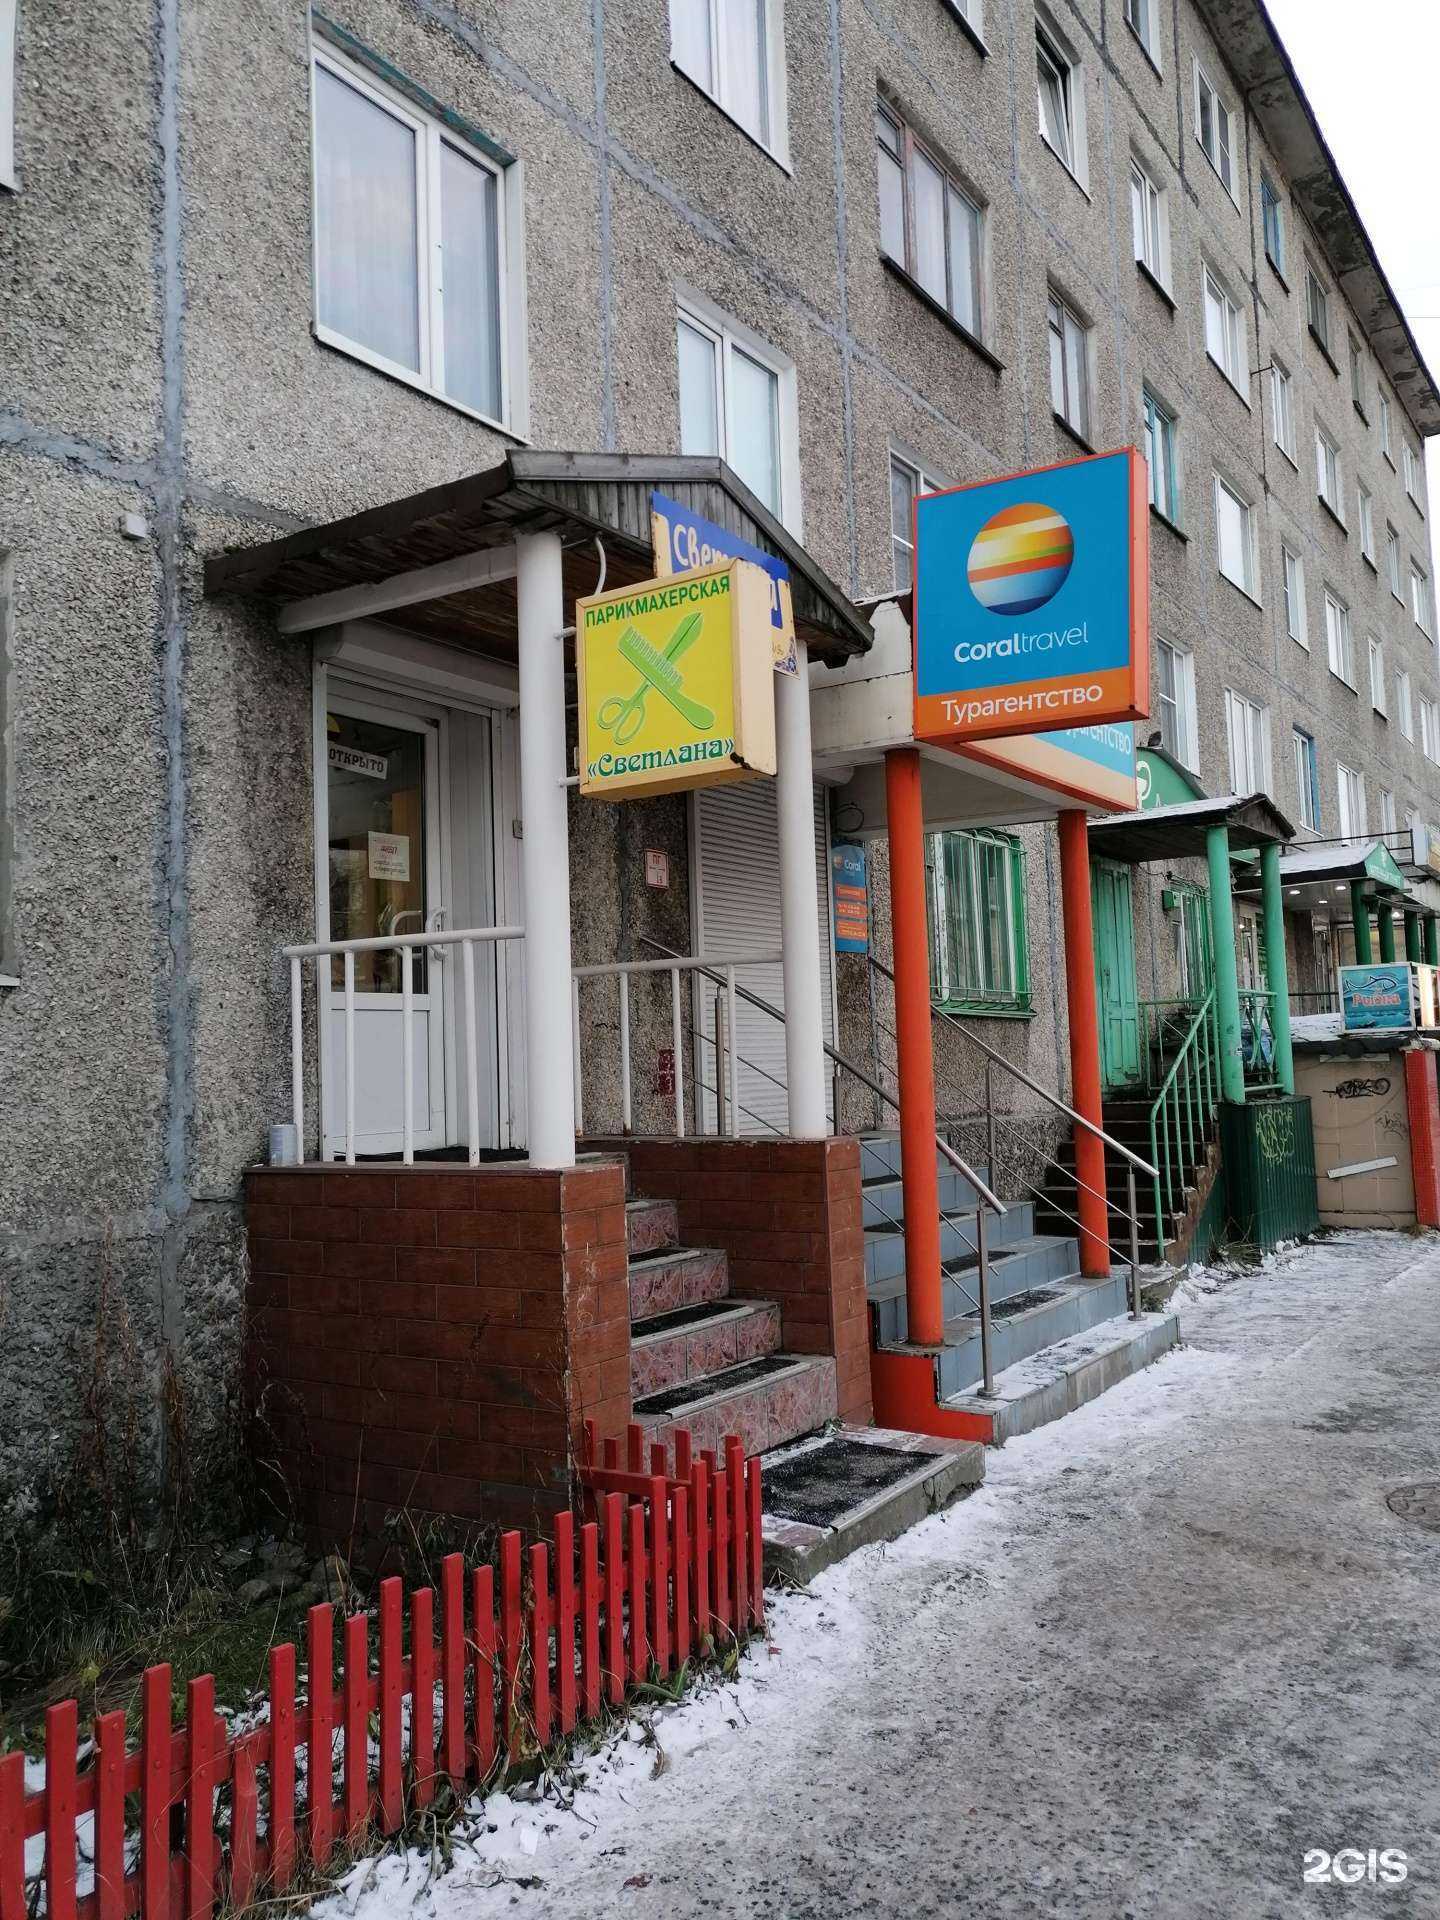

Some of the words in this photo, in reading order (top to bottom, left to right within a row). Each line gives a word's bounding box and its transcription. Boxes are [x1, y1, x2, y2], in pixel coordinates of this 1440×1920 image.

[585, 575, 731, 628] ПАРИКМАХЕРСКАЯ
[941, 684, 1103, 725] Турагентство
[329, 748, 384, 773] ОТКРЫТО
[587, 736, 735, 777] «Светлана»
